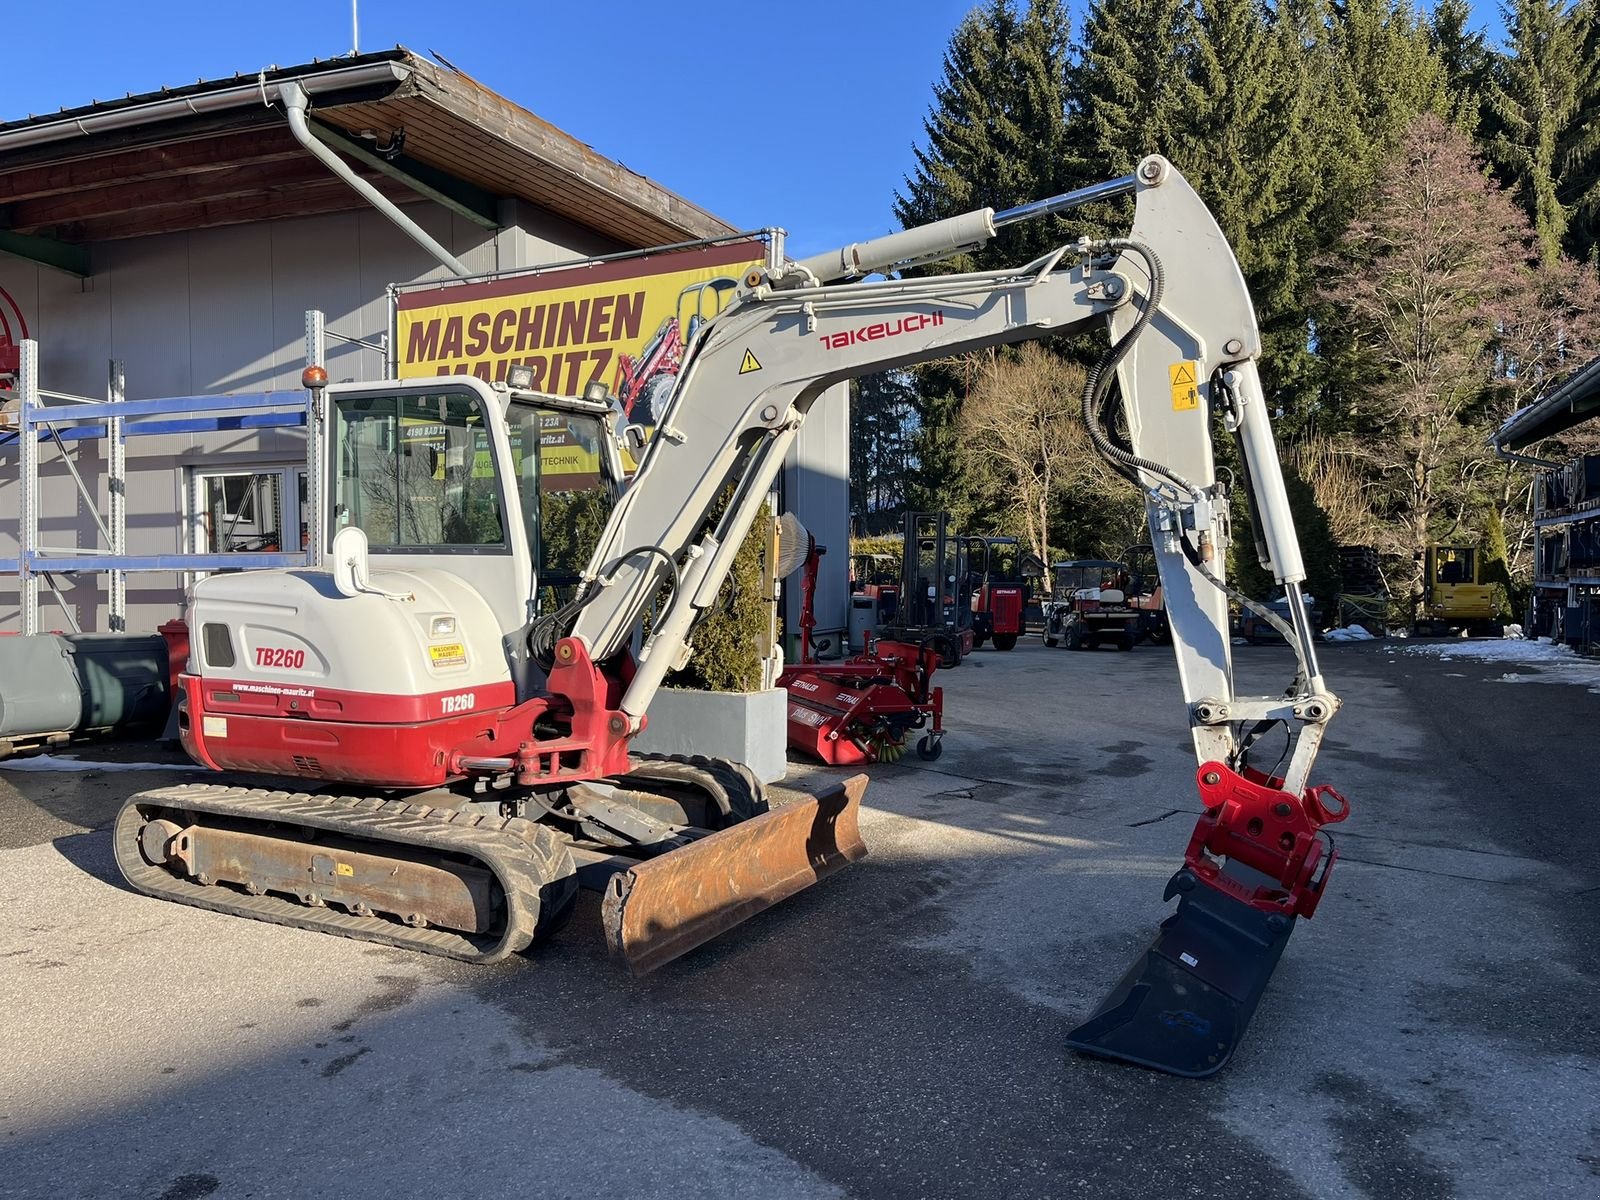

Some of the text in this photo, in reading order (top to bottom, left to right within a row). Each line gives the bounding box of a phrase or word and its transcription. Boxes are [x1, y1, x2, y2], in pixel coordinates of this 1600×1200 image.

[405, 291, 646, 364] MASCHINEN
[436, 348, 613, 396] ARITZ
[406, 428, 423, 437] 4190
[424, 427, 438, 435] BAD
[543, 417, 559, 427] 23A
[255, 647, 305, 669] TB260
[232, 683, 315, 697] www.maschinen-mauritz.at
[441, 693, 475, 713] TB260
